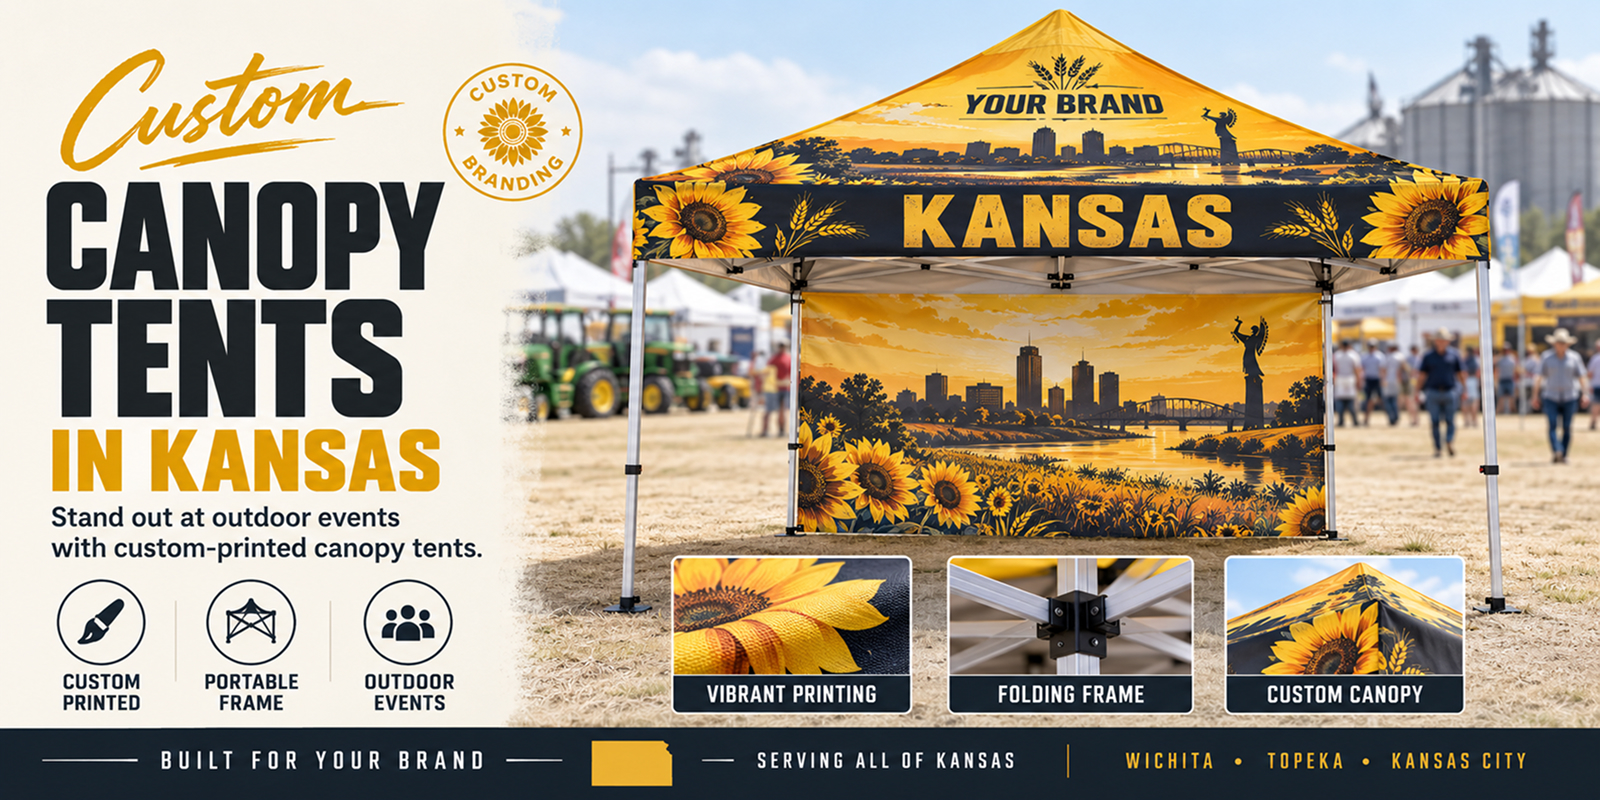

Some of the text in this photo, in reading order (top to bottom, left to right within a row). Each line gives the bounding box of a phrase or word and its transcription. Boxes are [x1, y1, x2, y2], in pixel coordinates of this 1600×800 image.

[966, 94, 1164, 114] YOUR BRAND
[904, 194, 1233, 248] KANSAS
